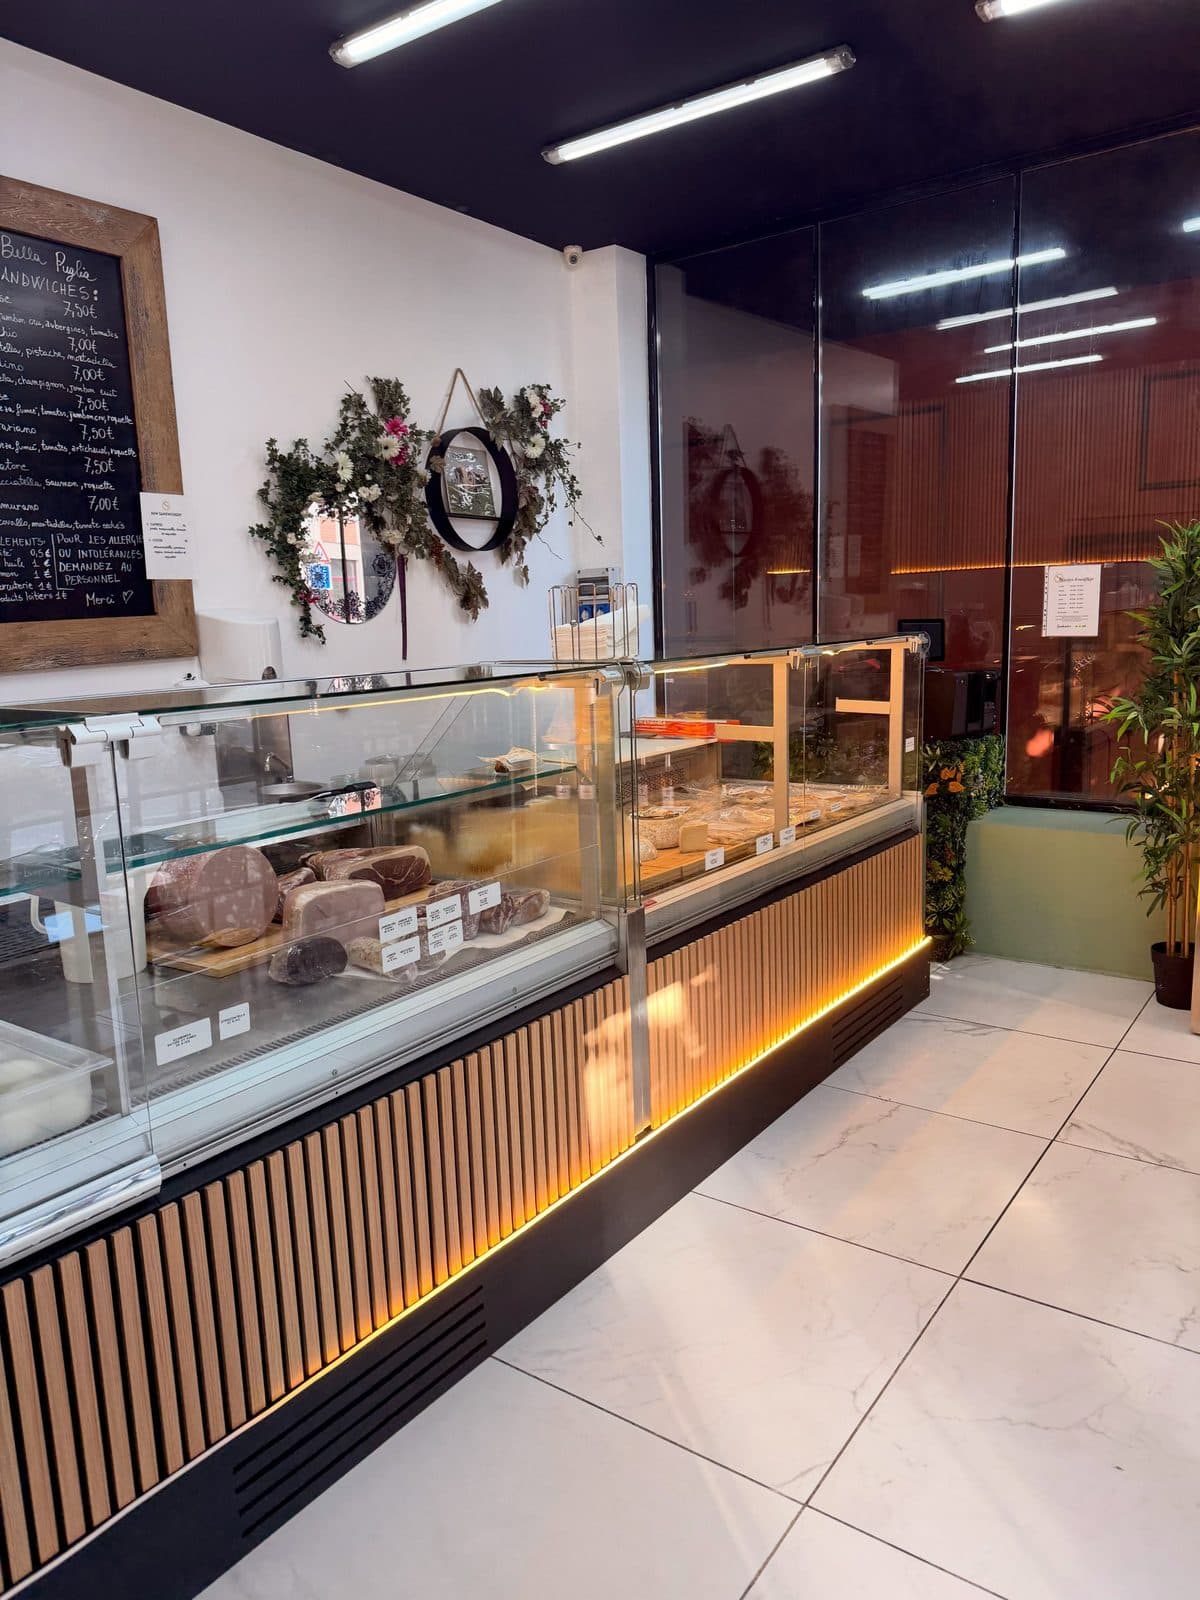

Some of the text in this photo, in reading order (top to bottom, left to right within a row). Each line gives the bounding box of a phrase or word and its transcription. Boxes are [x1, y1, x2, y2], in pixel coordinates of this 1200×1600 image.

[55, 251, 97, 282] Puglia
[62, 300, 98, 319] 7,50€
[67, 336, 98, 354] 7,00€
[71, 364, 106, 382] 7,00€
[75, 394, 109, 412] 7,50€
[80, 423, 115, 441] 7,50€
[83, 456, 116, 475] 7,50€
[87, 495, 120, 512] 7,00€
[88, 534, 106, 545] LES
[58, 548, 72, 558] OU
[58, 561, 132, 573] DEMANDEZ AU
[64, 573, 121, 586] PERSONNEL
[85, 591, 116, 607] Merci
